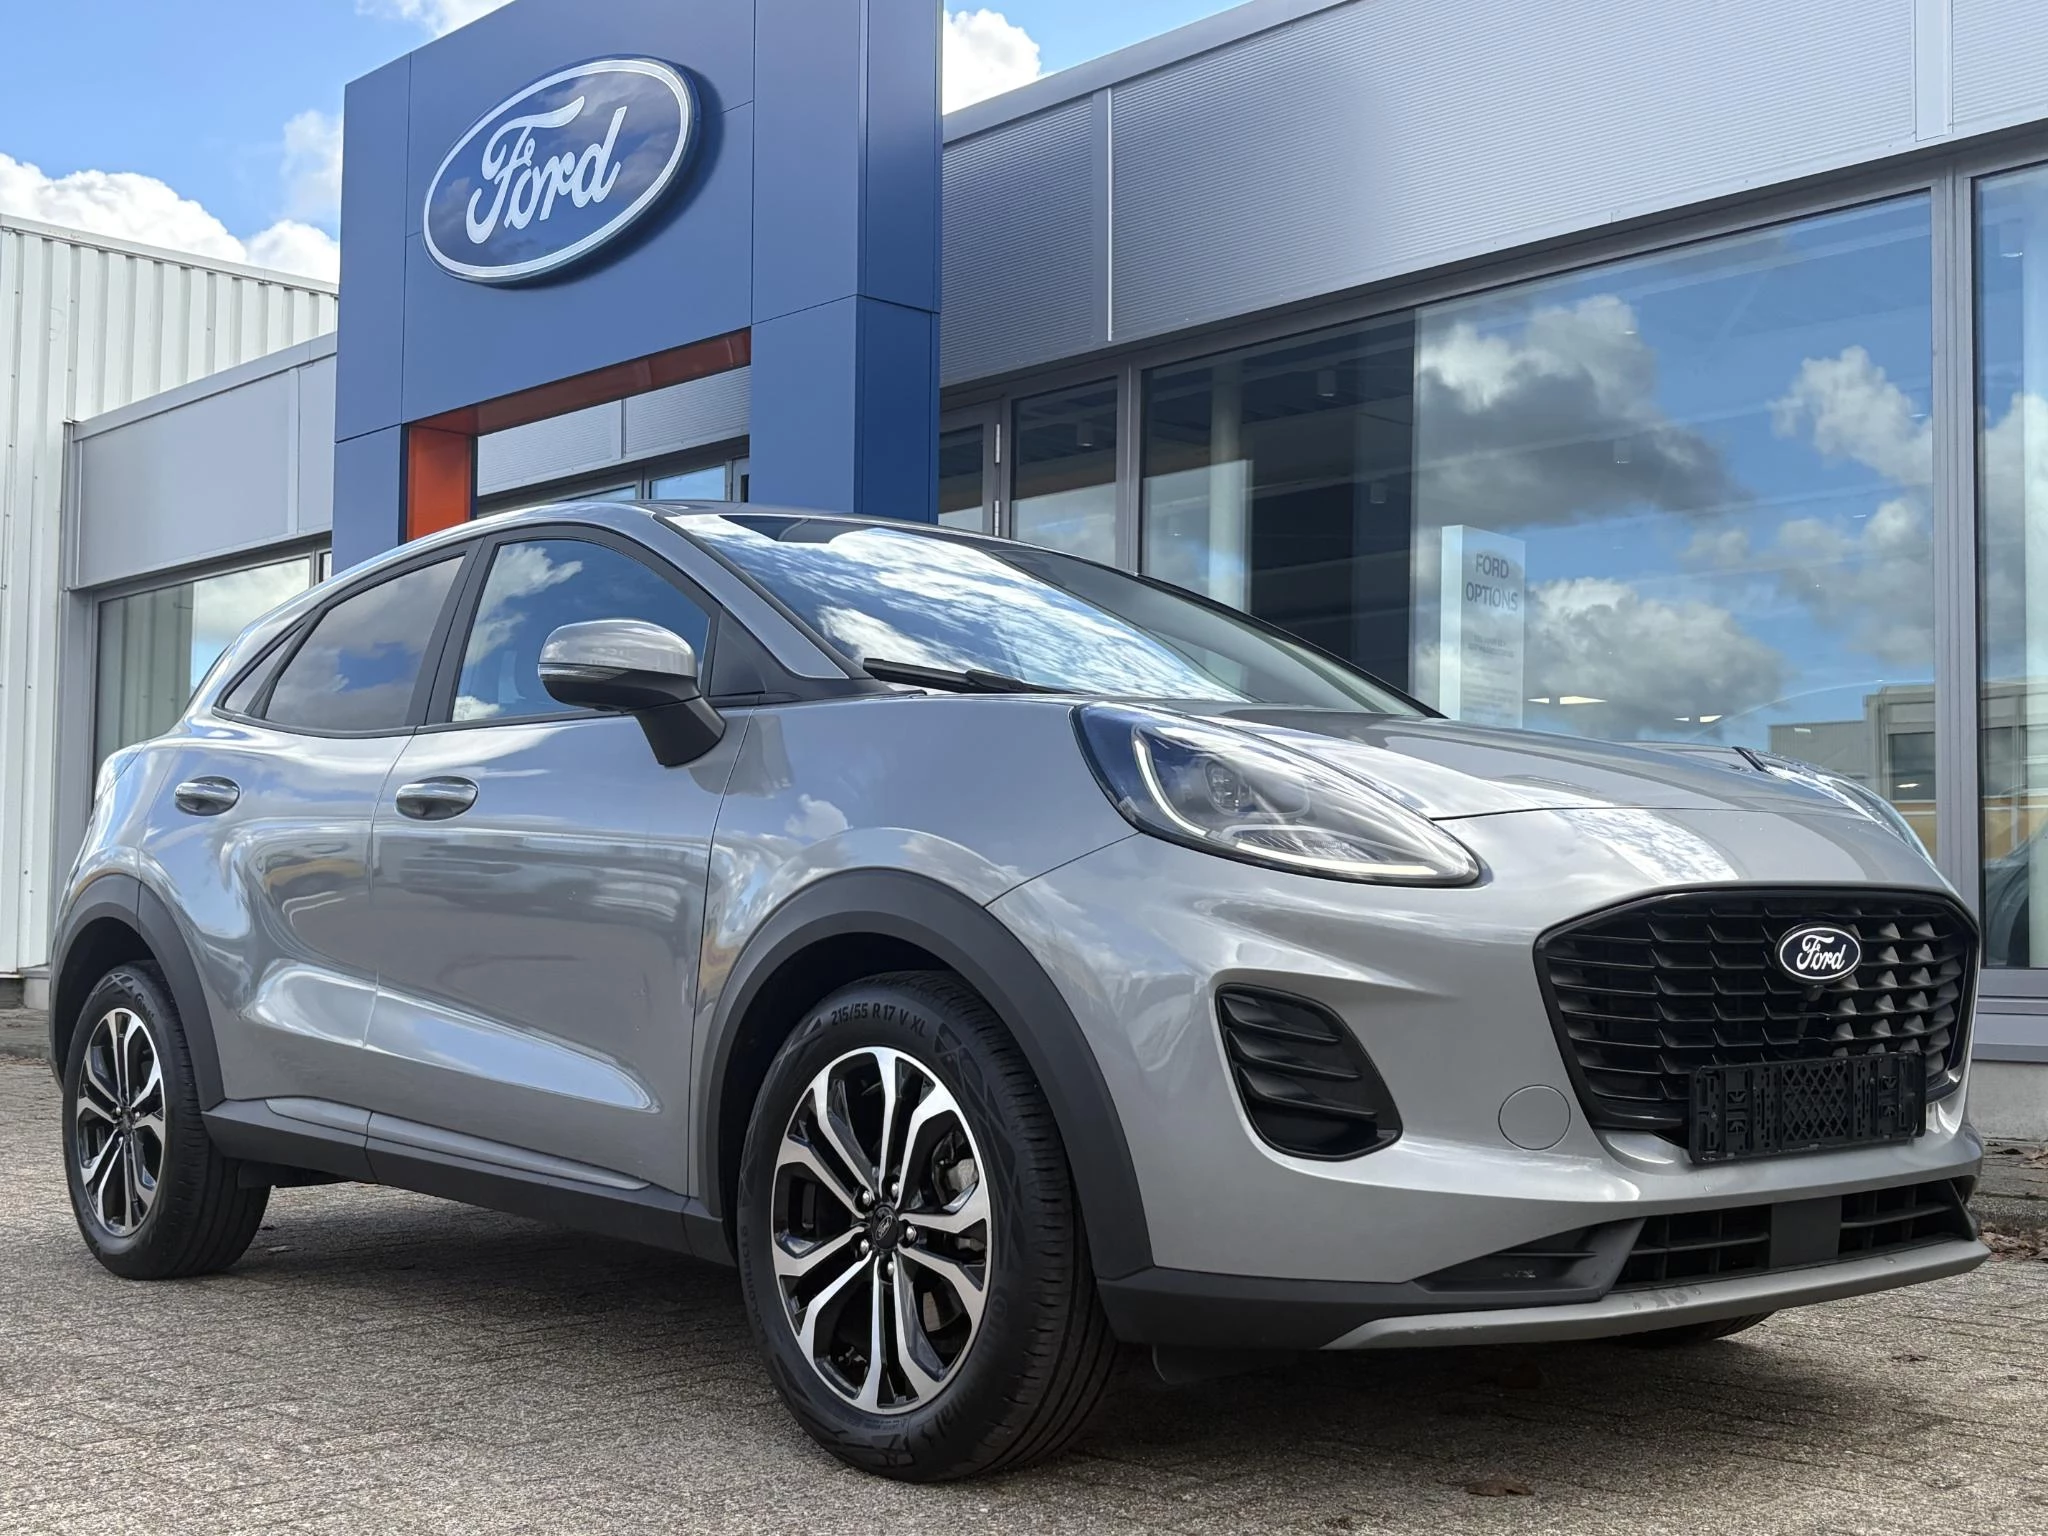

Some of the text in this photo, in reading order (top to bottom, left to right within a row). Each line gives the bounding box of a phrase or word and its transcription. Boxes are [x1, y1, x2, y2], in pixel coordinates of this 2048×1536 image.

[465, 95, 628, 245] Ford
[1475, 552, 1510, 579] FORD
[1465, 582, 1519, 611] OPTIONS
[1796, 934, 1847, 971] Ford
[830, 1002, 869, 1027] 215/55
[899, 1008, 910, 1026] V
[910, 1015, 927, 1038] XL
